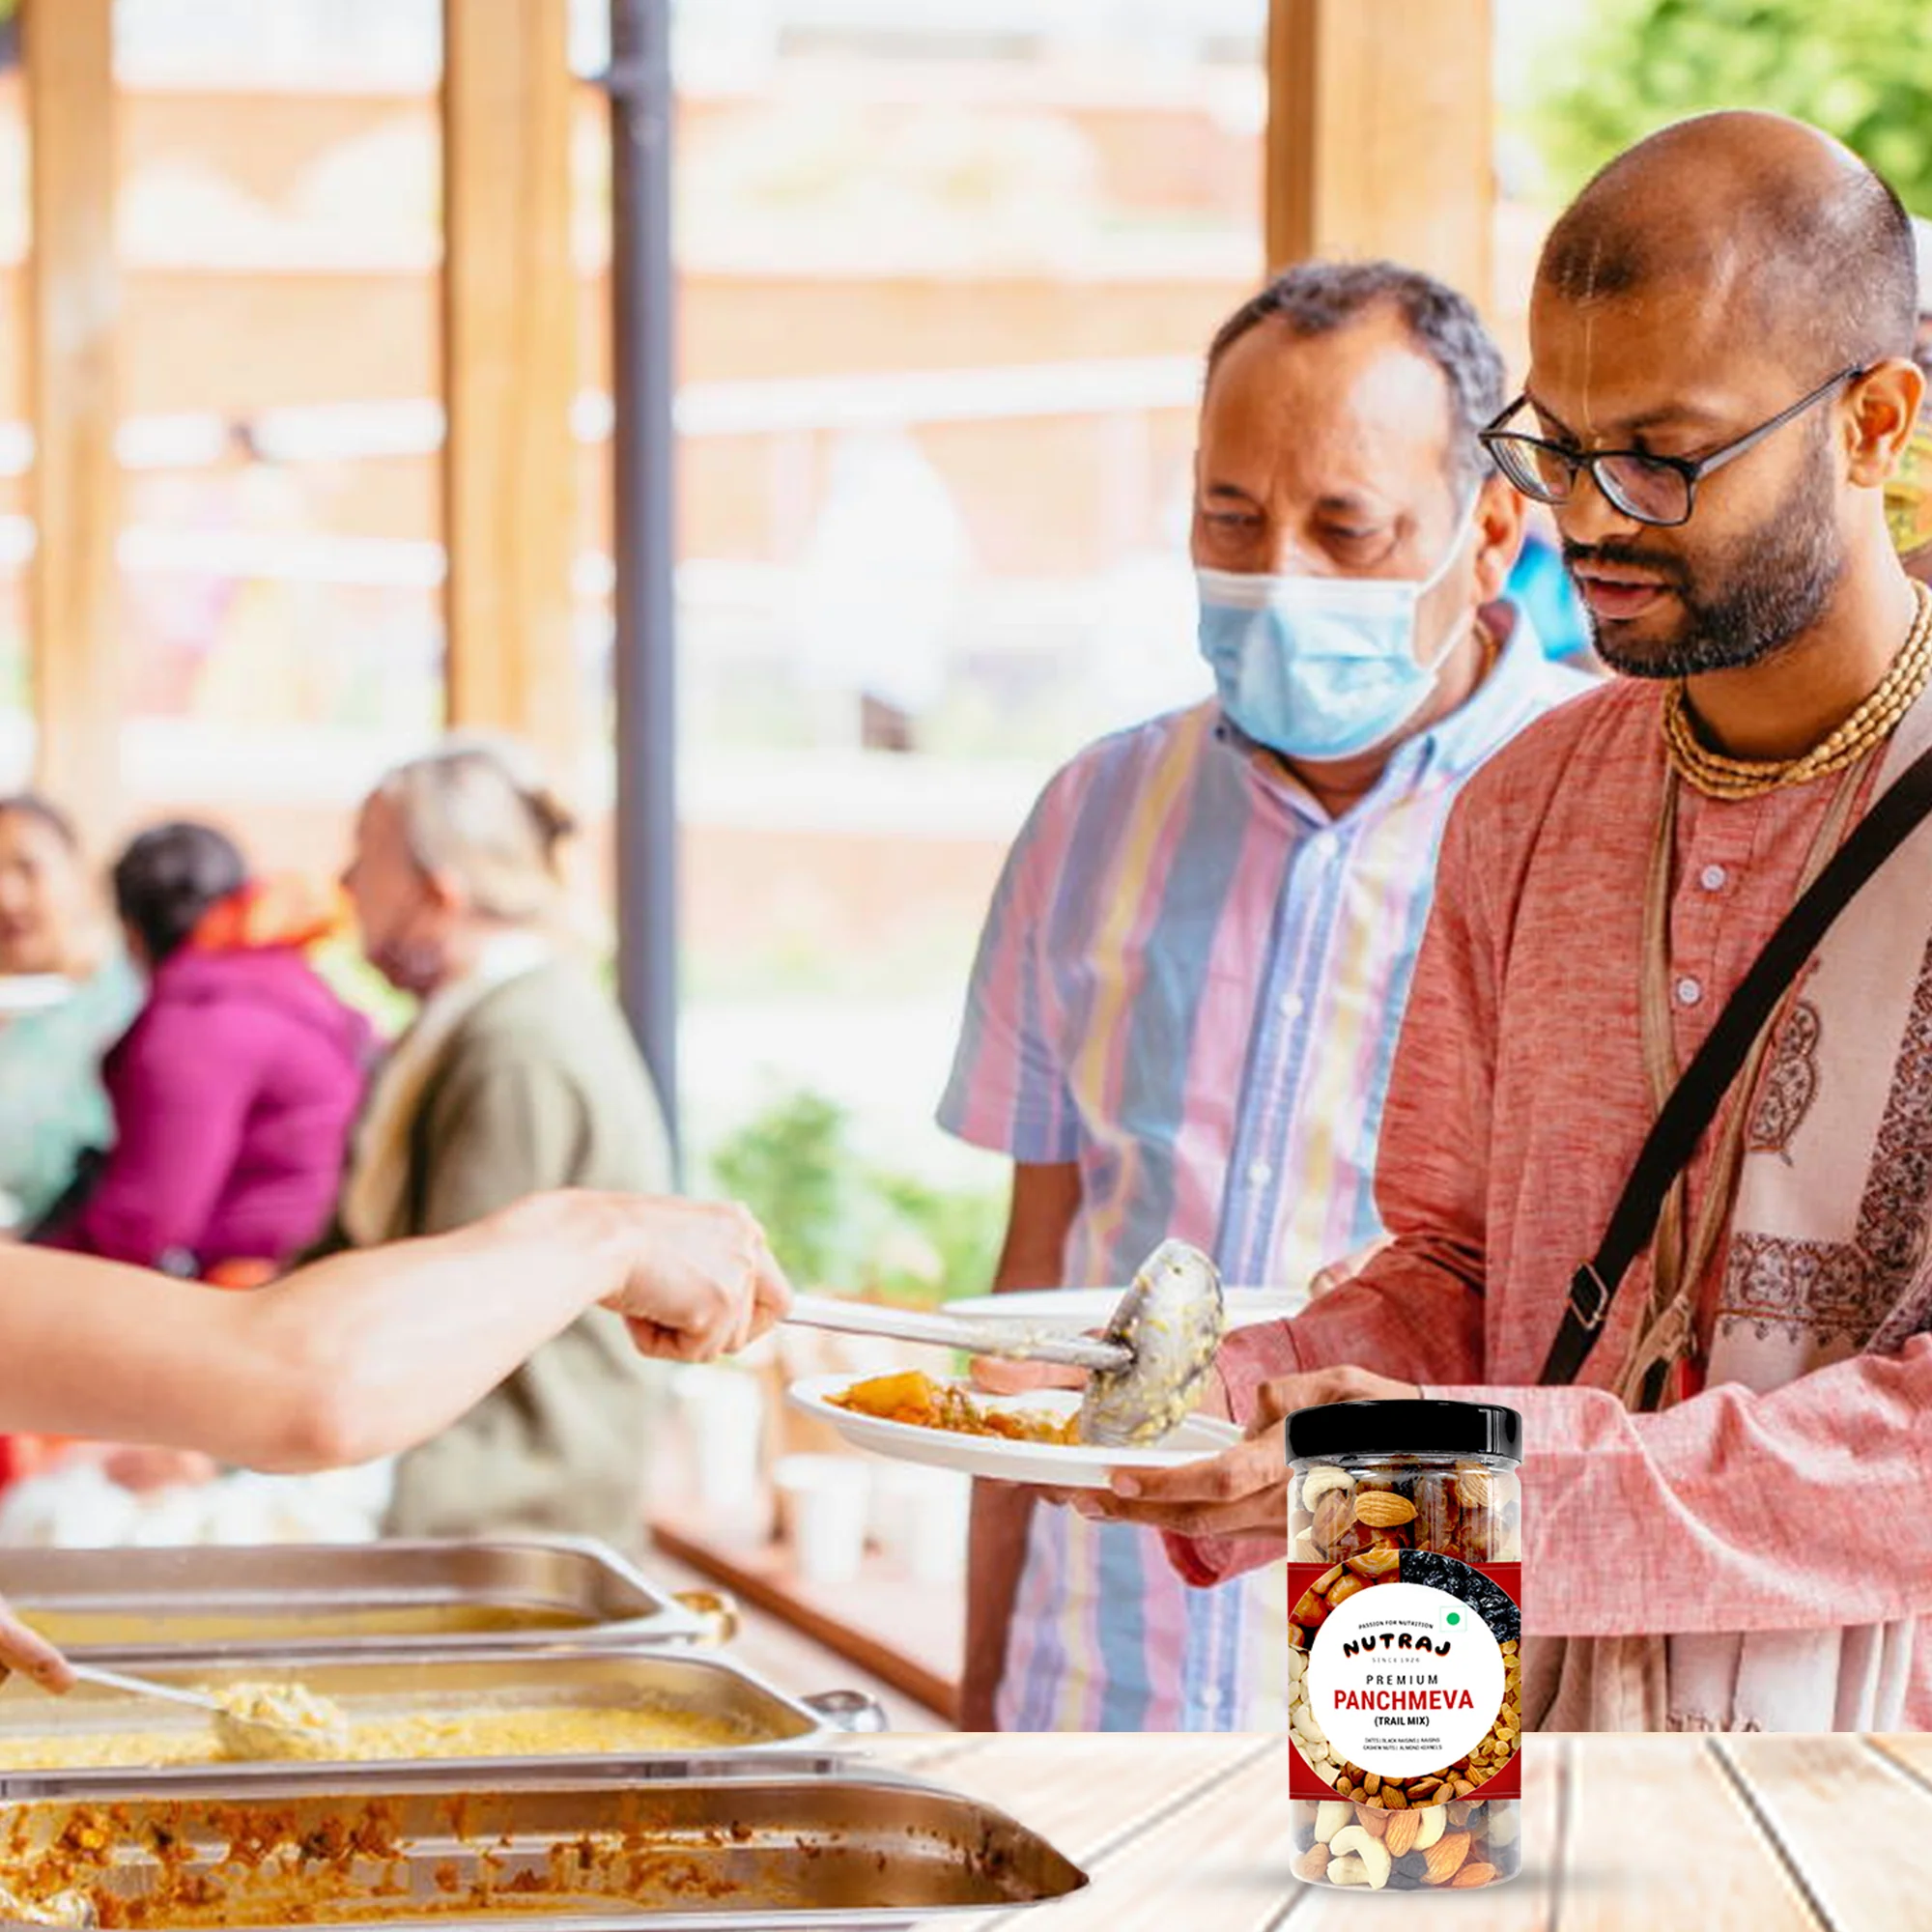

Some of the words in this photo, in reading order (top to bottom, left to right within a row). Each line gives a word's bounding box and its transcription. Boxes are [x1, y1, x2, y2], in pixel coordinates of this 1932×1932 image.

[1358, 1621, 1384, 1630] PASSION
[1399, 1620, 1434, 1629] NUTRITION
[1343, 1633, 1451, 1659] NUTRAJ
[1366, 1674, 1438, 1685] PREMIUM
[1334, 1690, 1474, 1711] PANCHMEVA
[1374, 1716, 1406, 1727] (TRAIL
[1406, 1716, 1430, 1727] MIX)
